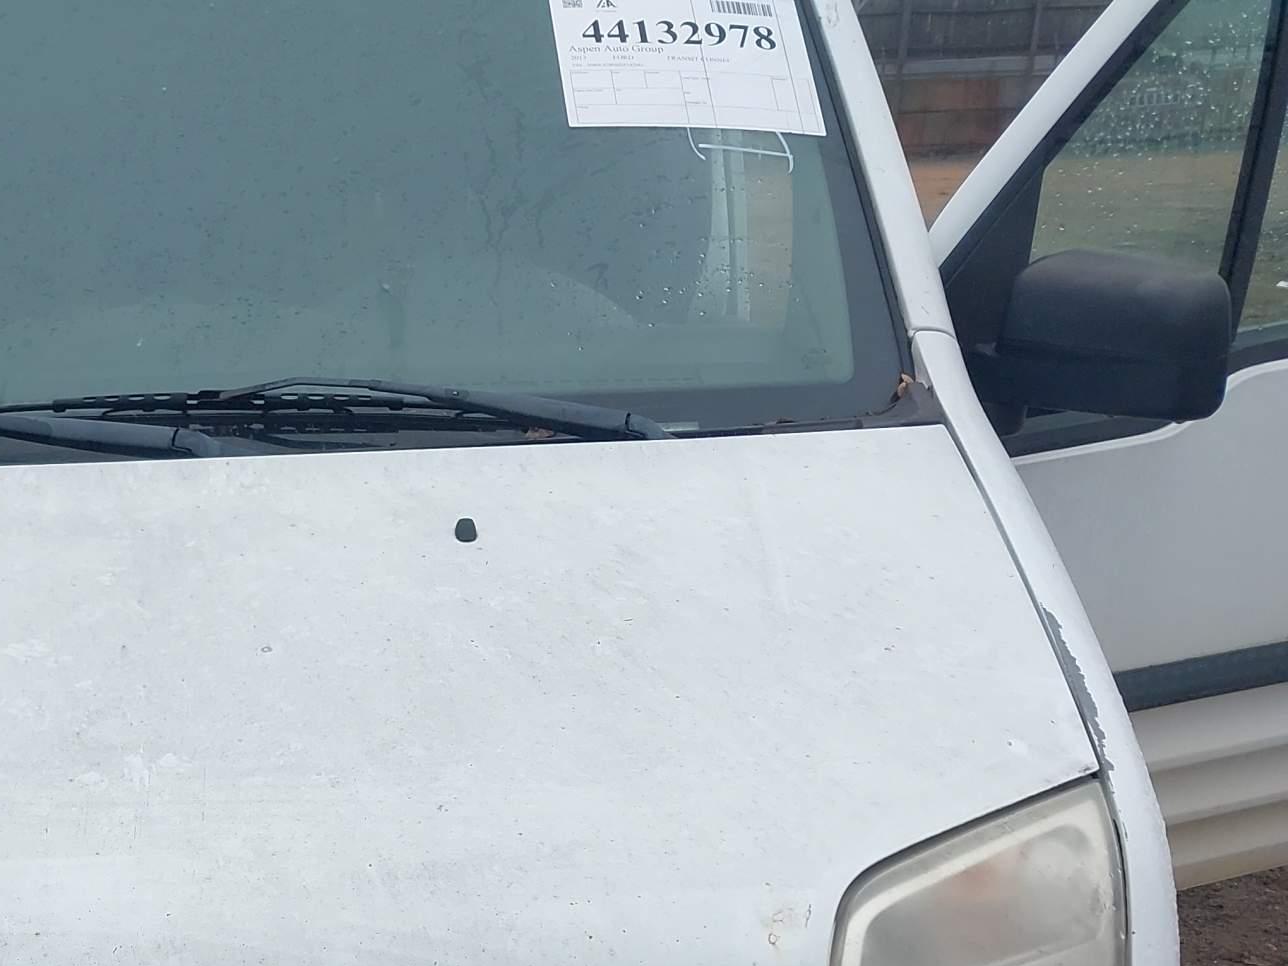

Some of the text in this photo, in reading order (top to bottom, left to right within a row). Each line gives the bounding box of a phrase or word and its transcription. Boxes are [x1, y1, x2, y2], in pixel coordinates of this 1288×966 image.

[582, 19, 777, 50] 44132978
[568, 45, 664, 54] Aspen Auto Group
